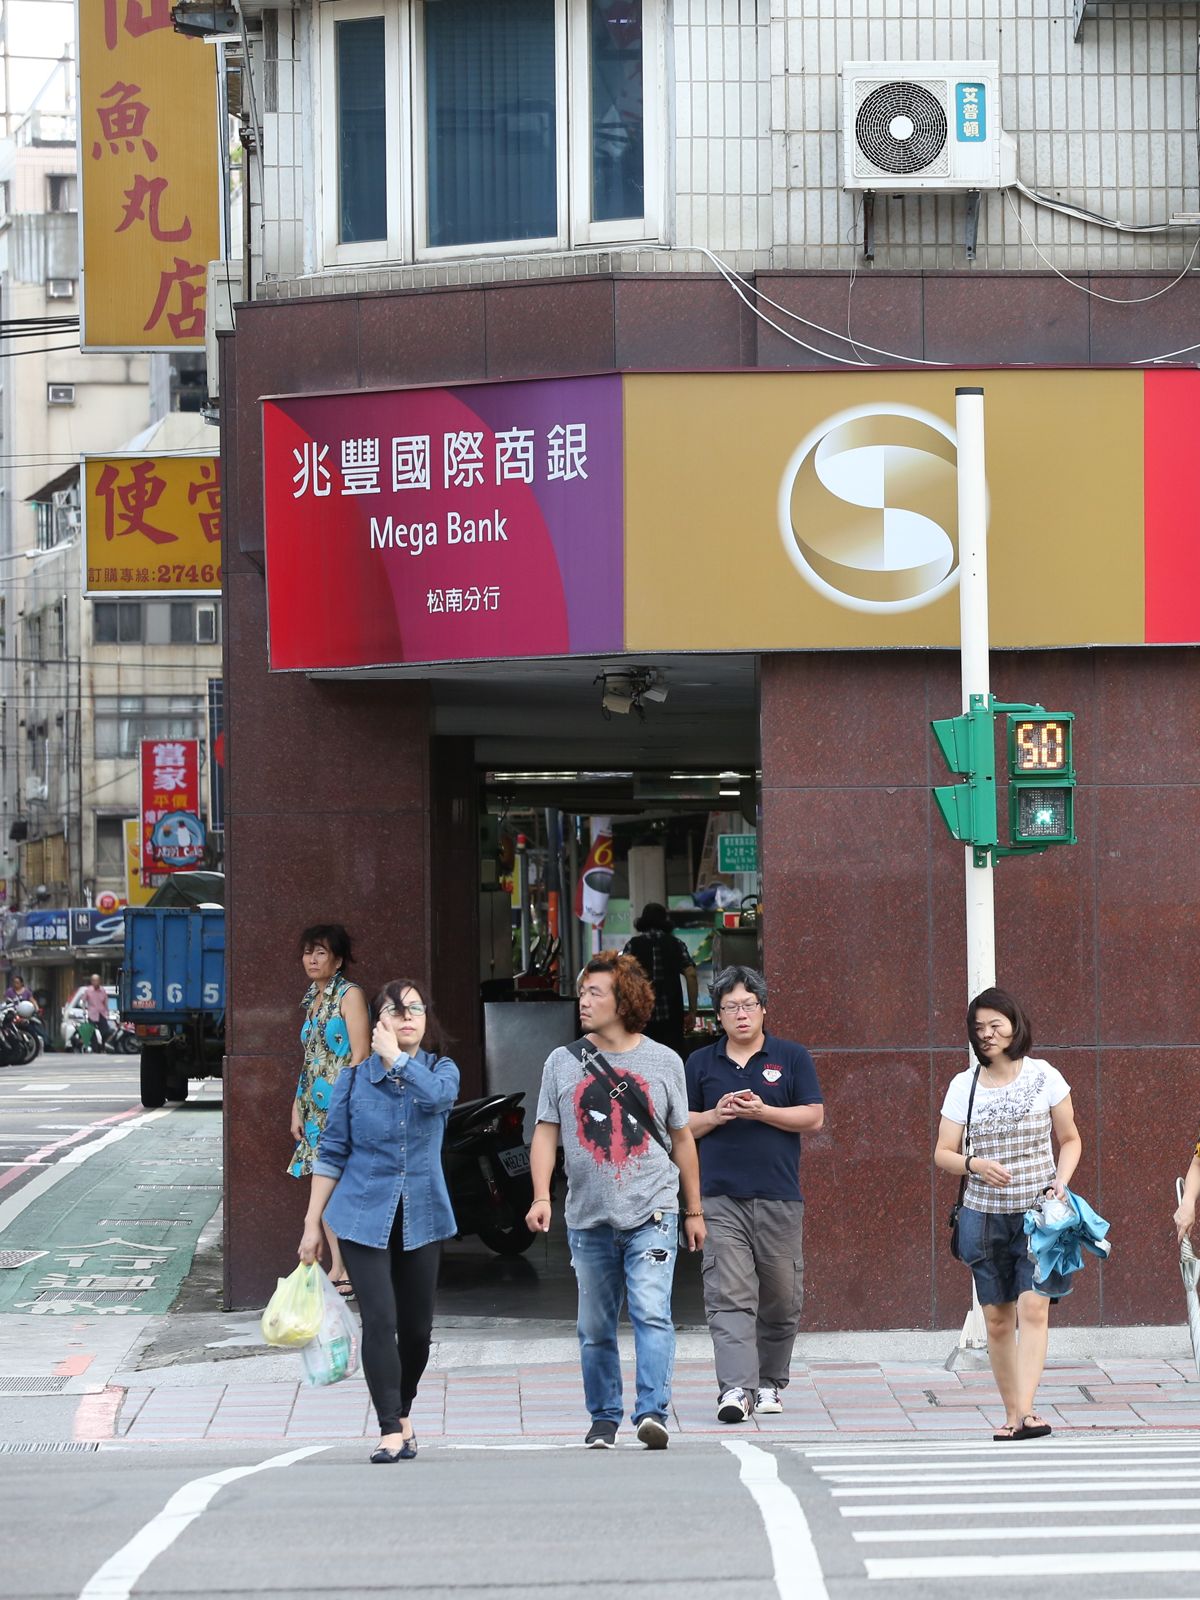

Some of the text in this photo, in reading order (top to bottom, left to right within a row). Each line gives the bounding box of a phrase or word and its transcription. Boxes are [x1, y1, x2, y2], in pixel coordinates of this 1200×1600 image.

[962, 87, 980, 137] 艾普頓
[292, 423, 589, 499] 兆豐國際商銀
[370, 509, 508, 556] Mega Bank
[88, 564, 222, 584] 訂購專線:2746
[426, 586, 501, 614] 松南分行
[1017, 723, 1063, 768] 50
[136, 981, 219, 1004] 365
